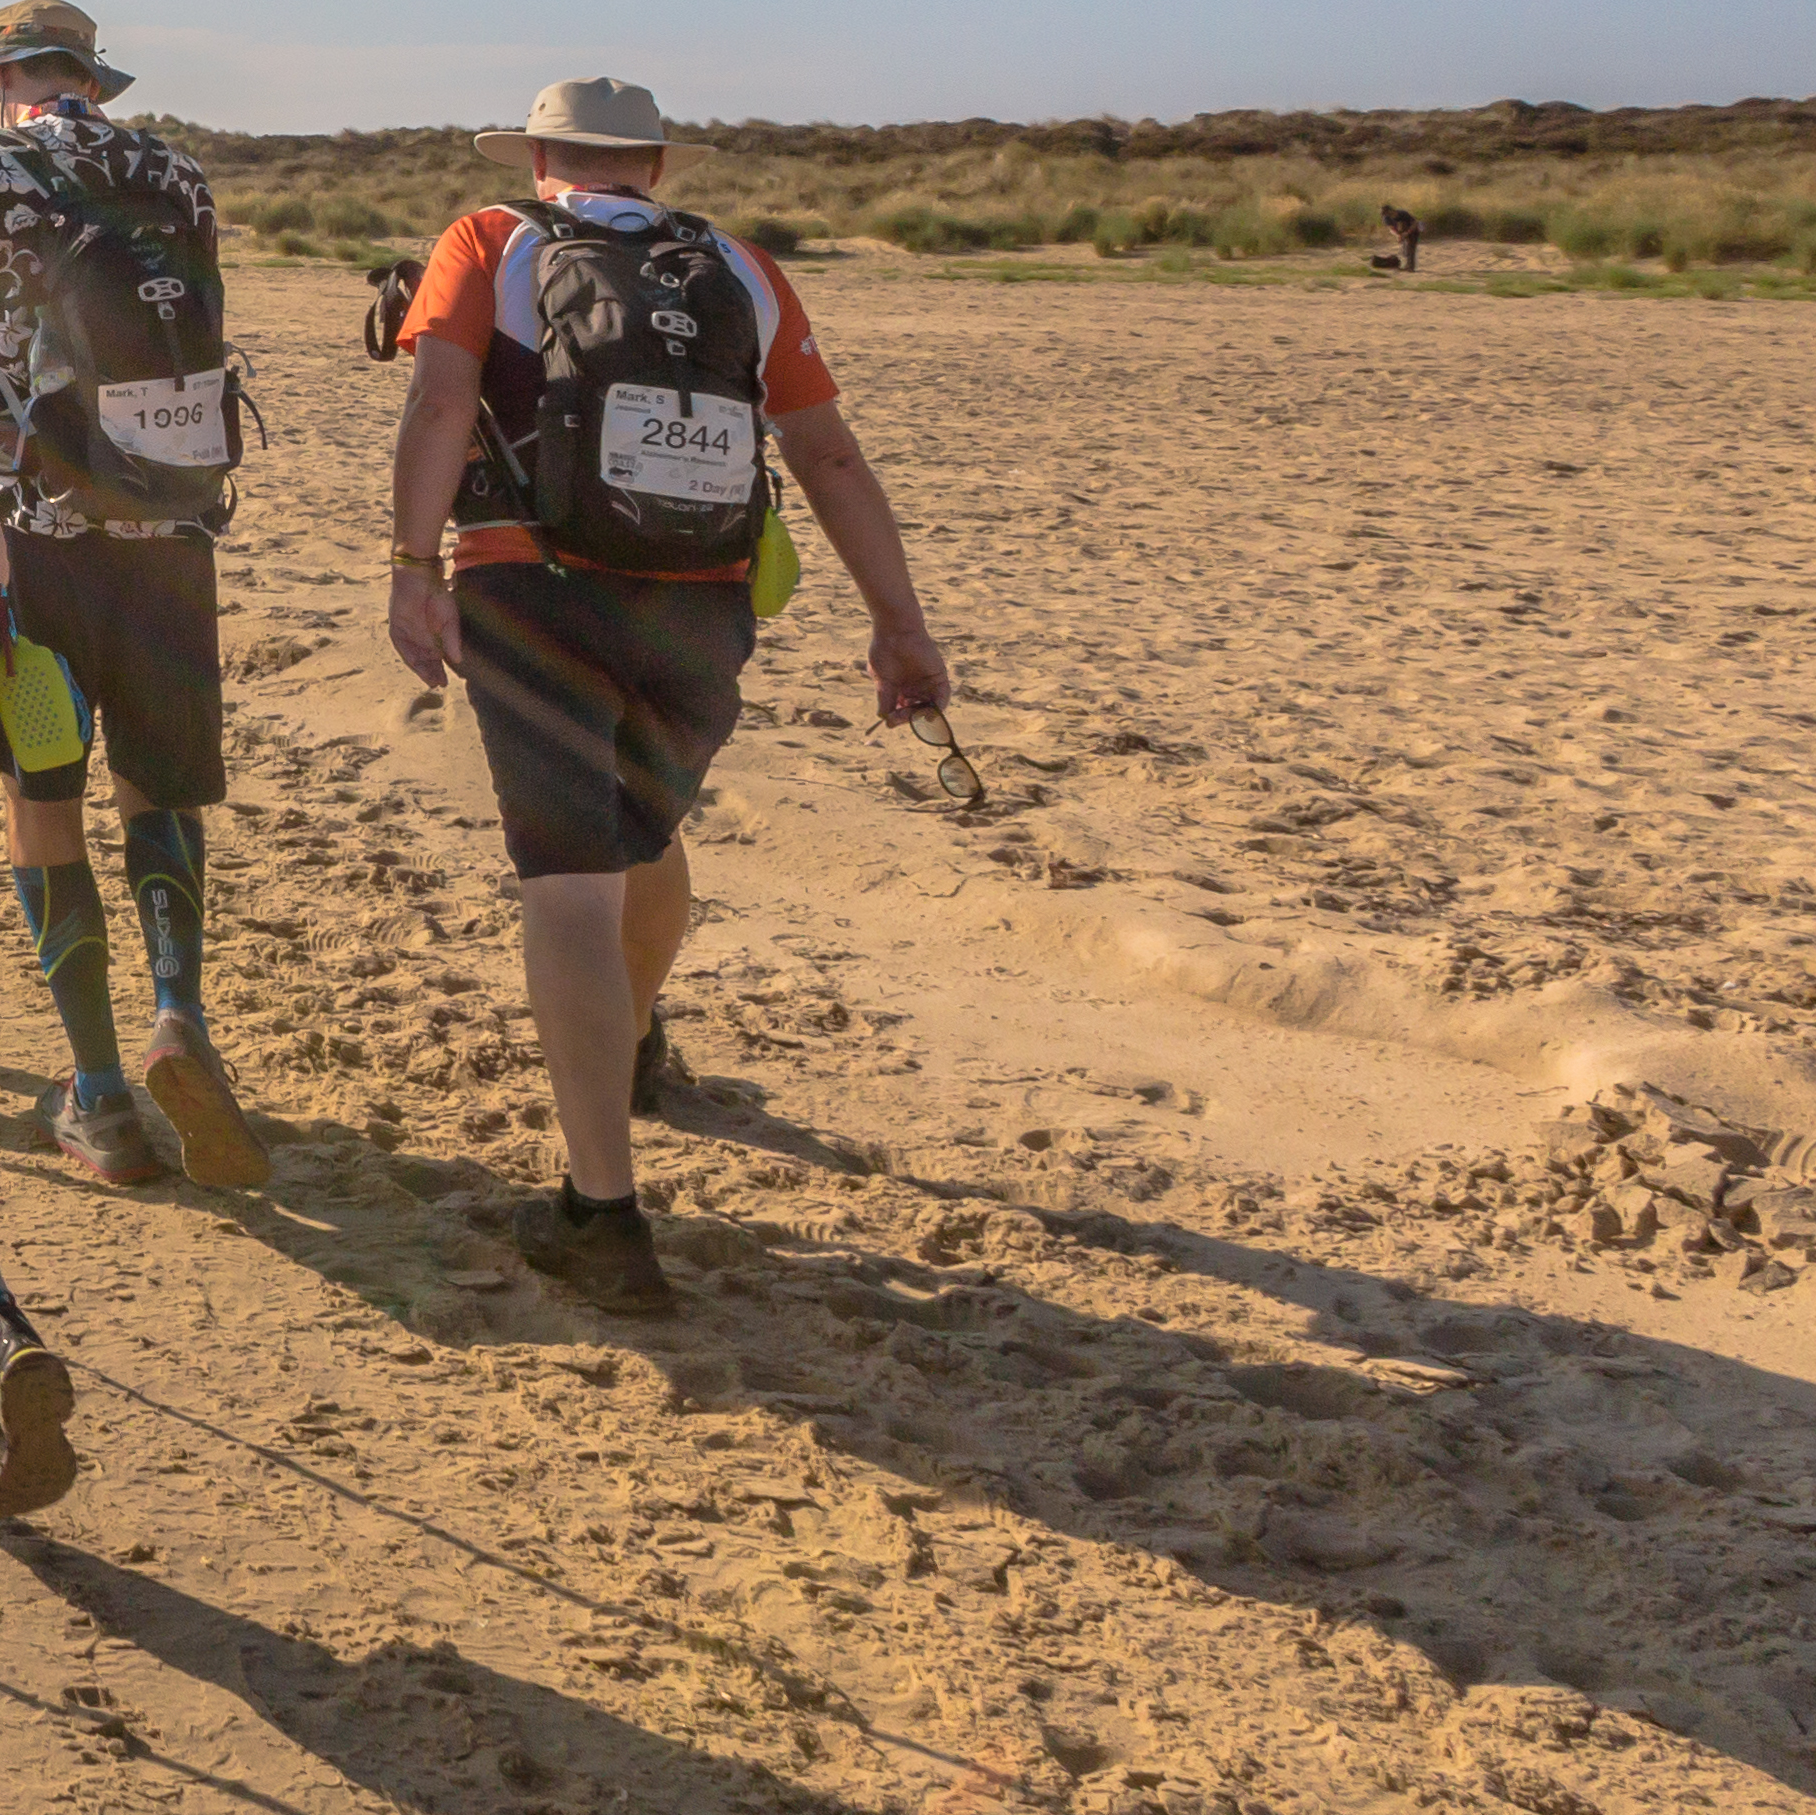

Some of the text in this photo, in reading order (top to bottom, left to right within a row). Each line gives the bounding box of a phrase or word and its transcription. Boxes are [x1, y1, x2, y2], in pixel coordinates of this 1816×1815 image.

[106, 387, 148, 398] Mark, T
[655, 394, 665, 405] S
[640, 417, 730, 456] 2844
[687, 479, 698, 491] 2
[702, 481, 728, 496] Day
[152, 889, 174, 956] SKINS
